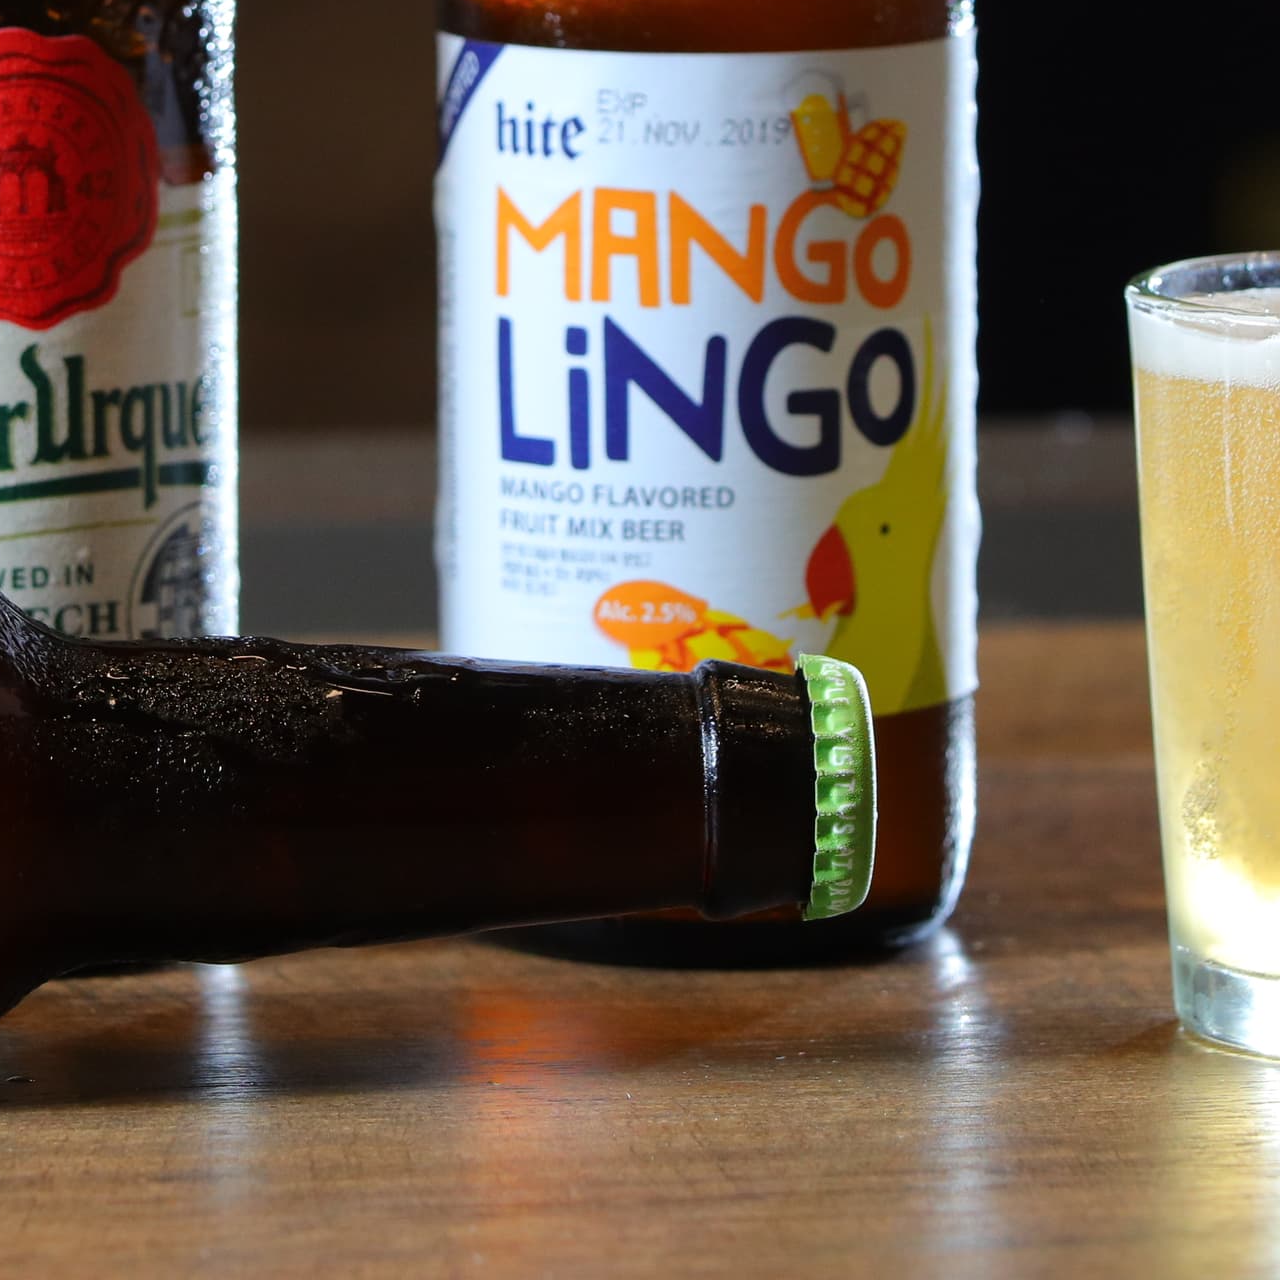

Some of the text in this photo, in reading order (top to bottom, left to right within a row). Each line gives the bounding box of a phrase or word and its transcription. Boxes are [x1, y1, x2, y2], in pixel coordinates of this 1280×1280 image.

[597, 89, 648, 115] EXP
[496, 101, 585, 160] hite
[77, 171, 116, 200] 42
[495, 184, 911, 309] MANGO
[19, 344, 212, 509] Urque
[500, 476, 736, 509] MANGO FLAVORED
[500, 508, 685, 542] FRUIT MIX BEER
[65, 563, 94, 586] IN
